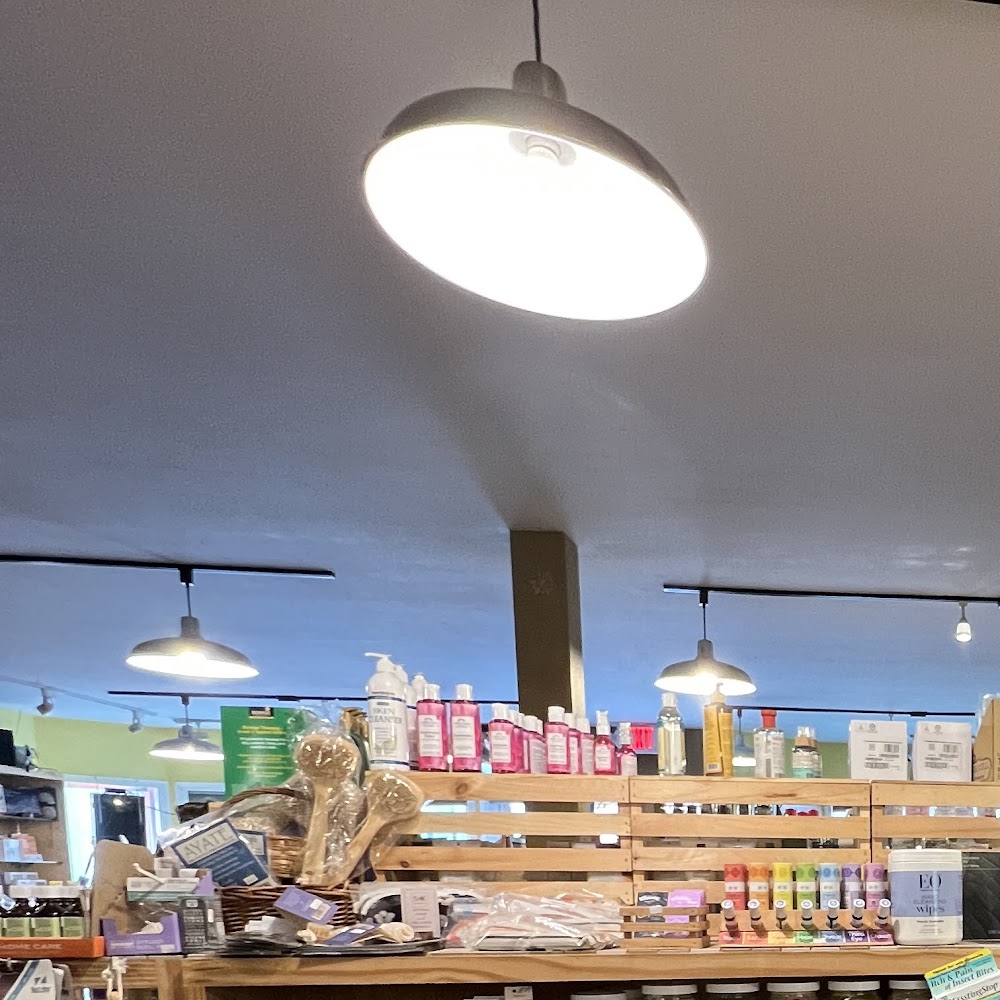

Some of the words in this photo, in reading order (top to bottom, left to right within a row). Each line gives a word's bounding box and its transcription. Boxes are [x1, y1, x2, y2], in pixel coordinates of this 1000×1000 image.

[184, 827, 233, 862] AYATE
[919, 873, 942, 889] EO
[916, 905, 945, 917] wipes
[955, 967, 973, 978] Pain
[952, 975, 974, 987] Insect
